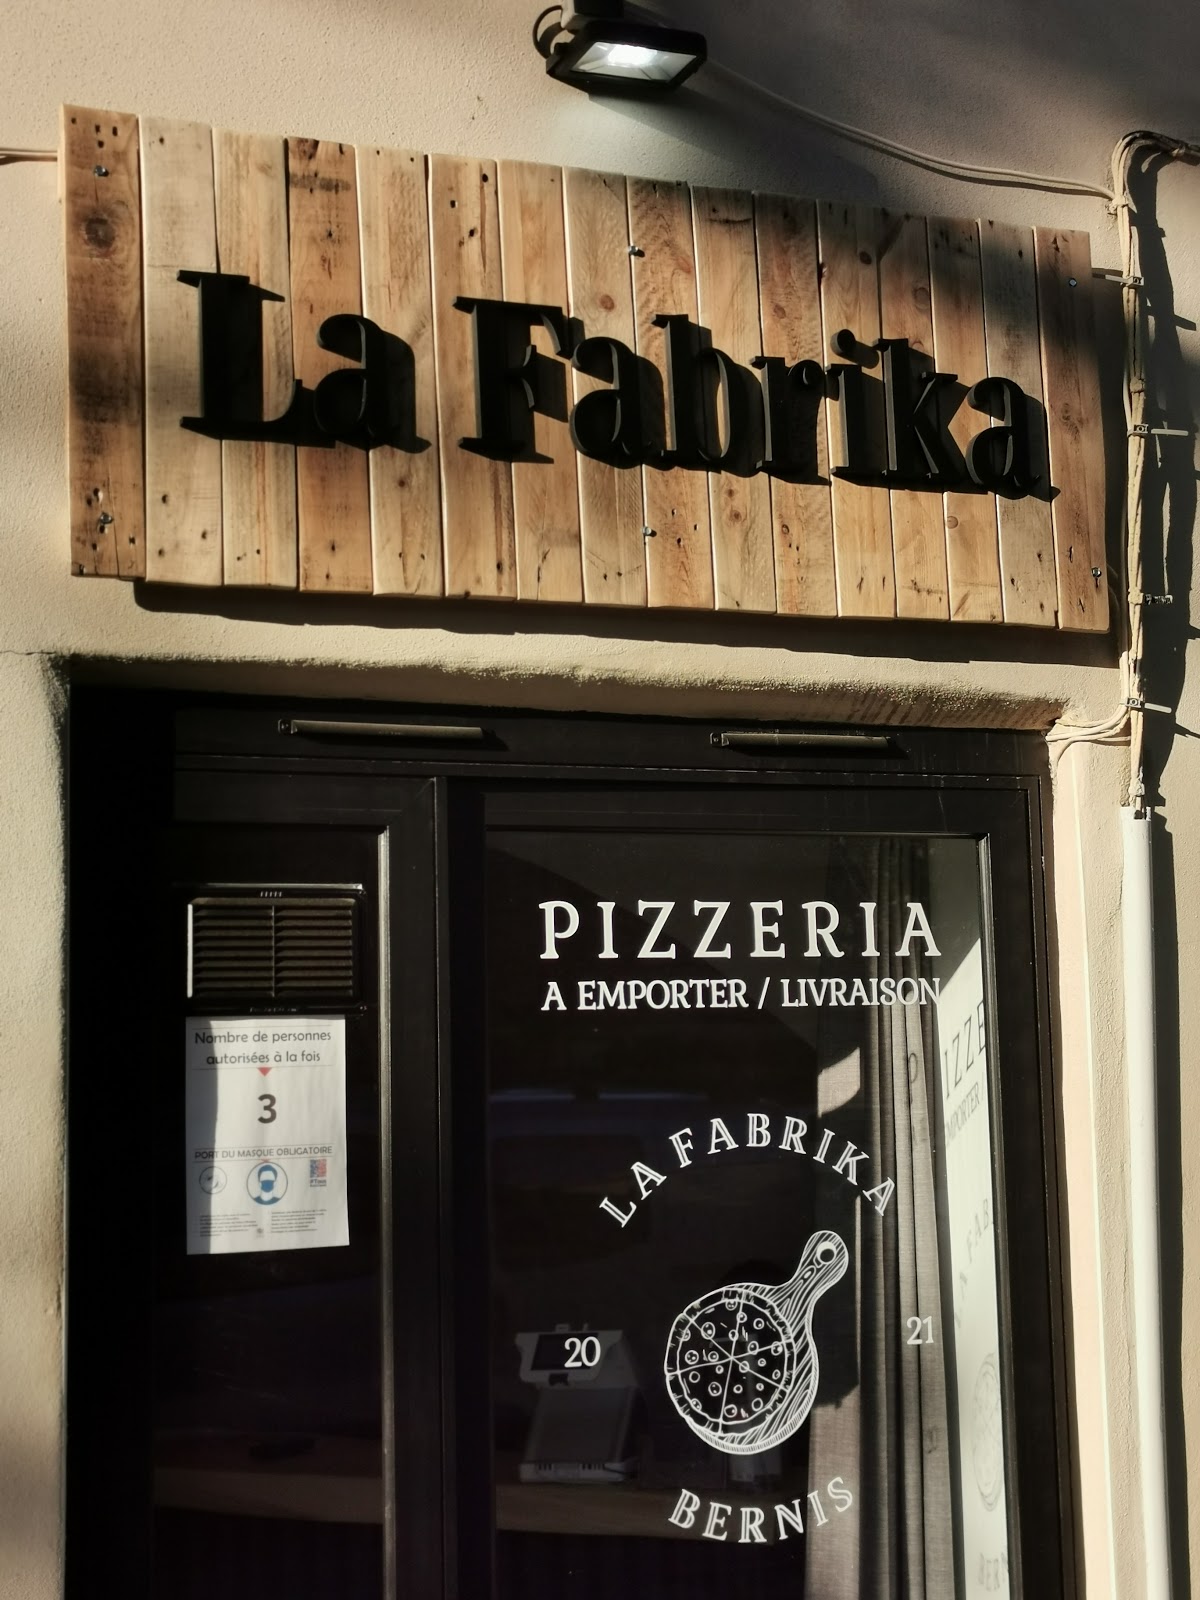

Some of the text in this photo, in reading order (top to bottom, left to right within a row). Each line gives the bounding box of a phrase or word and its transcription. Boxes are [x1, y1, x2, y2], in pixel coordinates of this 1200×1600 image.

[177, 269, 1060, 502] La Fabrika
[539, 900, 942, 960] PIZZERIA
[541, 981, 567, 1011] A
[577, 978, 749, 1010] EMPORTER
[780, 977, 942, 1008] LIVRAISON
[195, 1031, 332, 1044] Nombre de personnes
[206, 1050, 321, 1065] autorisées à la fois
[257, 1093, 277, 1124] 3
[194, 1146, 333, 1159] PORT DU MASQUE OBLIGATOIRE
[599, 1112, 897, 1228] LA FABRIKA
[906, 1316, 934, 1345] 21
[563, 1336, 602, 1368] 20
[668, 1476, 854, 1545] BERNIS
